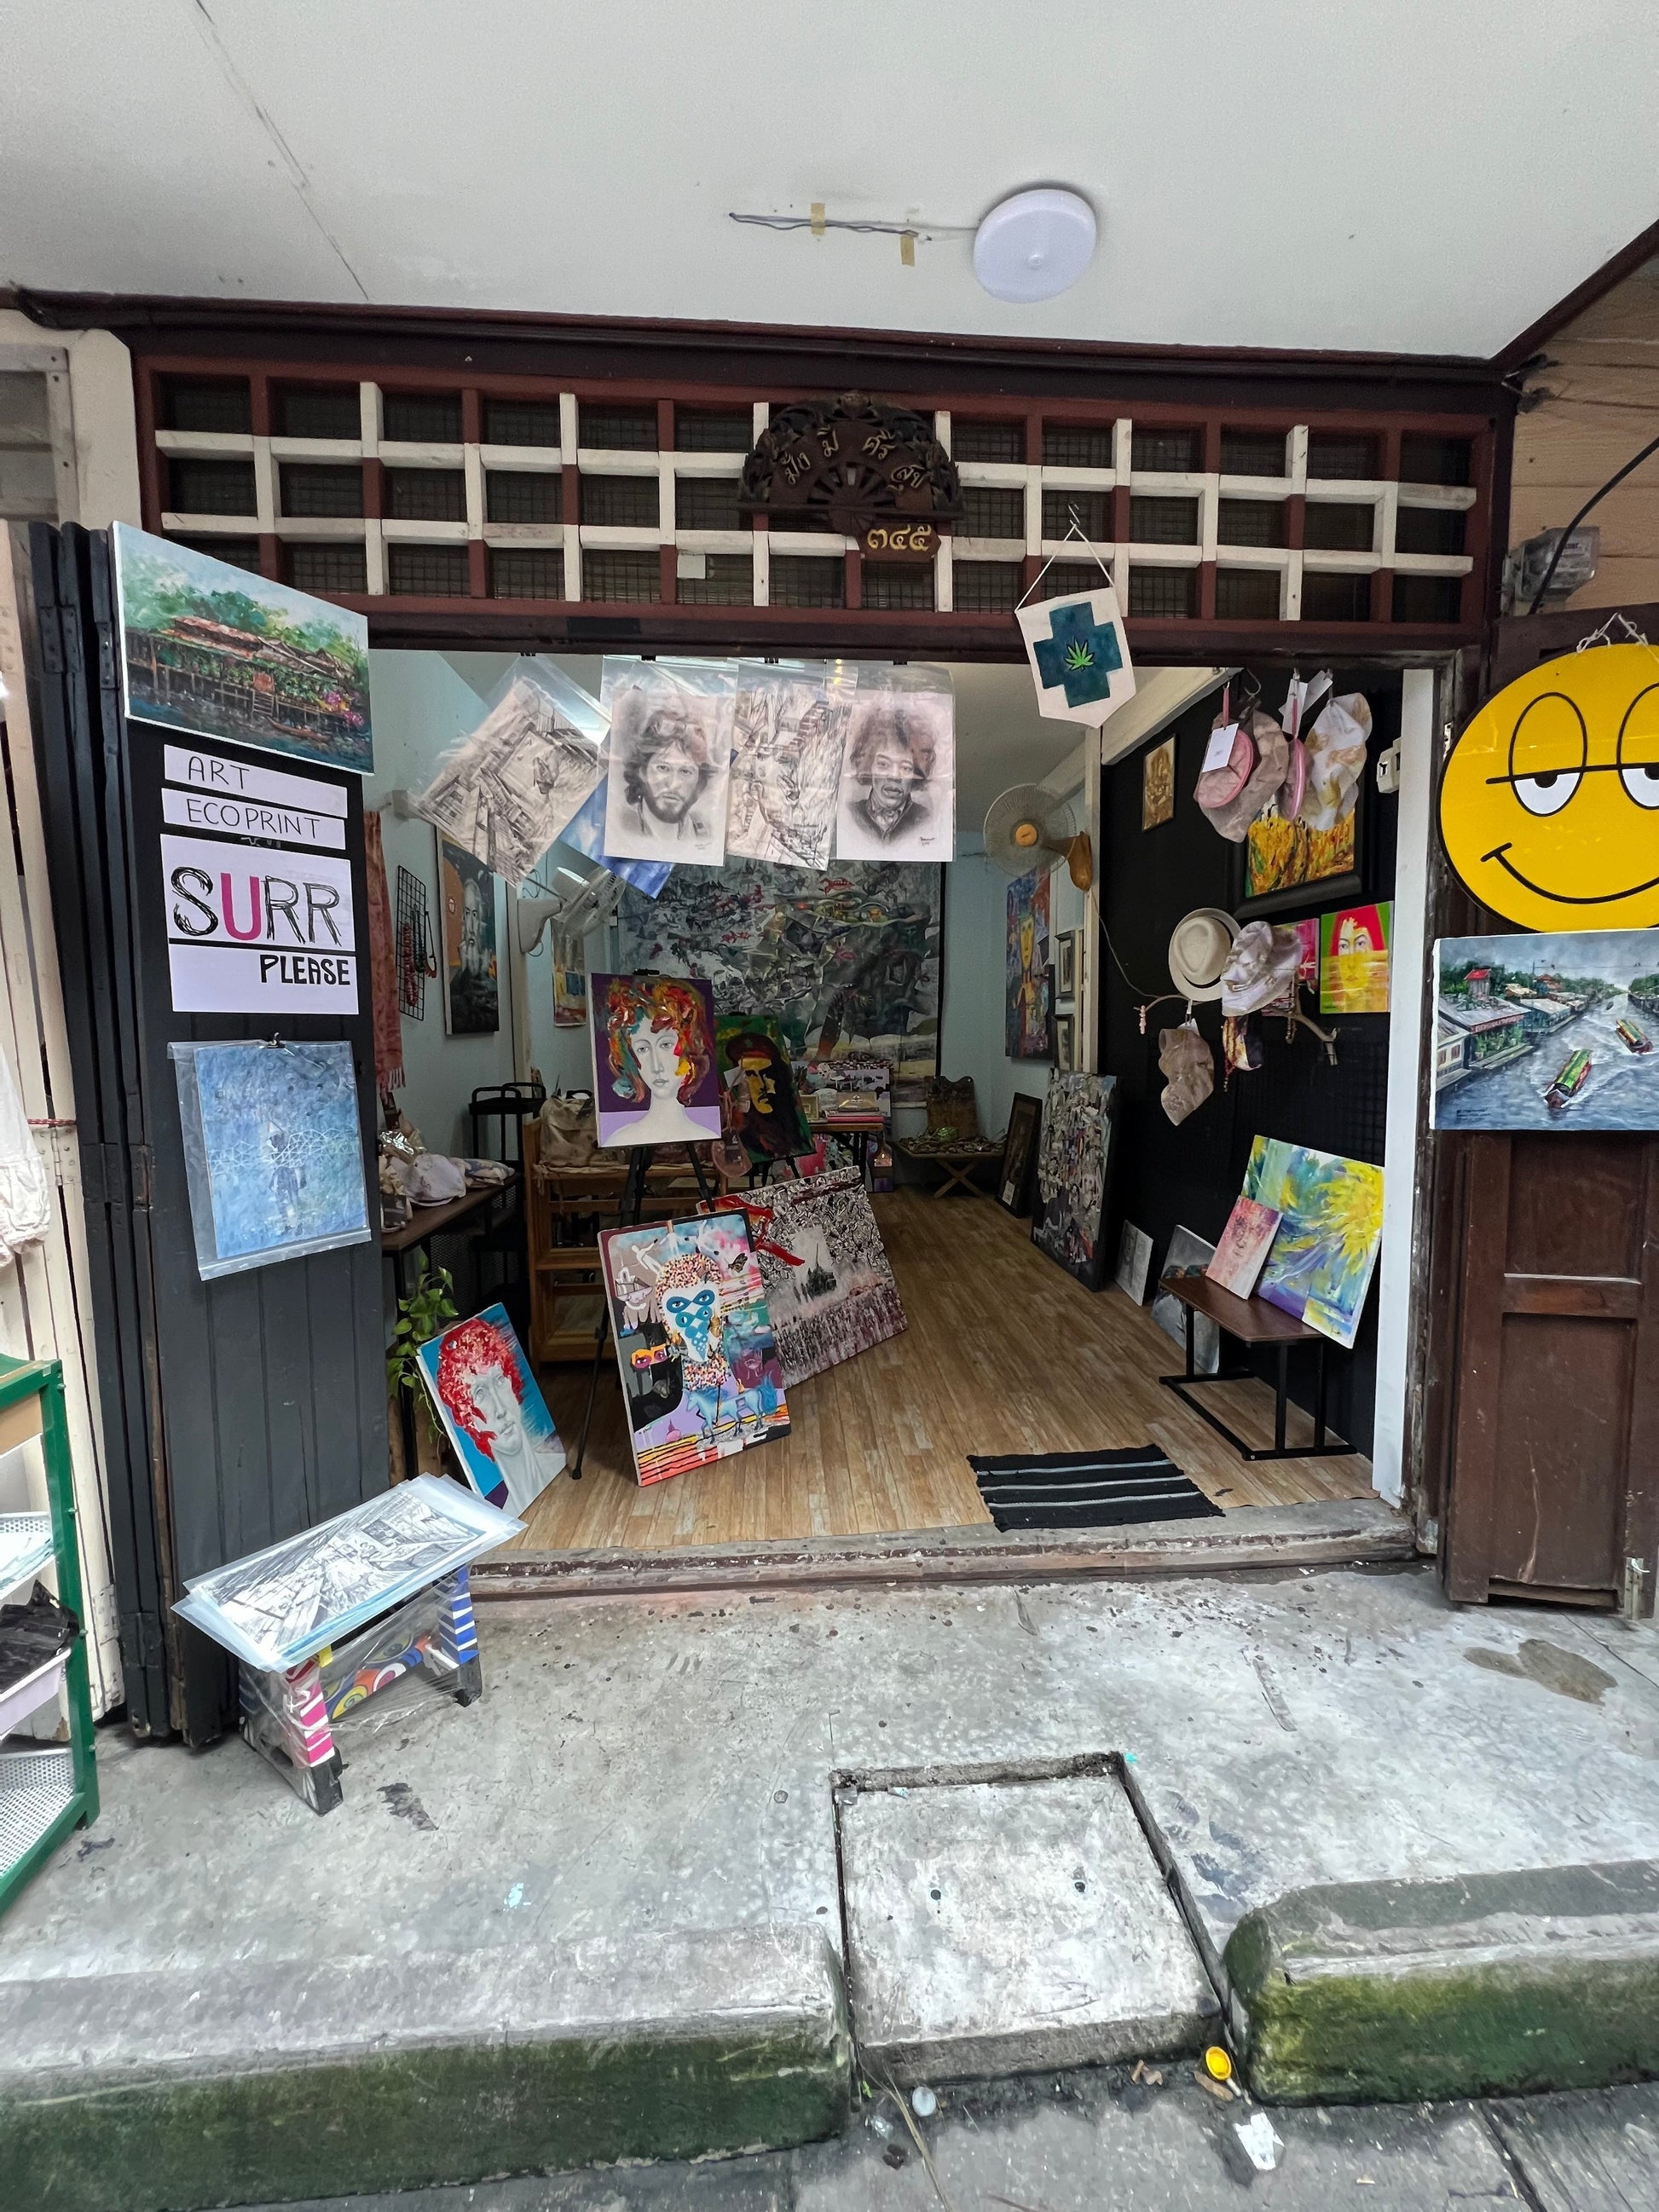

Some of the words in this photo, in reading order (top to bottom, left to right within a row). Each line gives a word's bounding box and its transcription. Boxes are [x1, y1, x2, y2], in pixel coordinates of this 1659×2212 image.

[866, 523, 932, 552] ๓๔๕
[188, 755, 251, 790] ART
[186, 798, 321, 839] ECOPRINT
[171, 866, 342, 947] SURR
[259, 954, 350, 985] PLEASE
